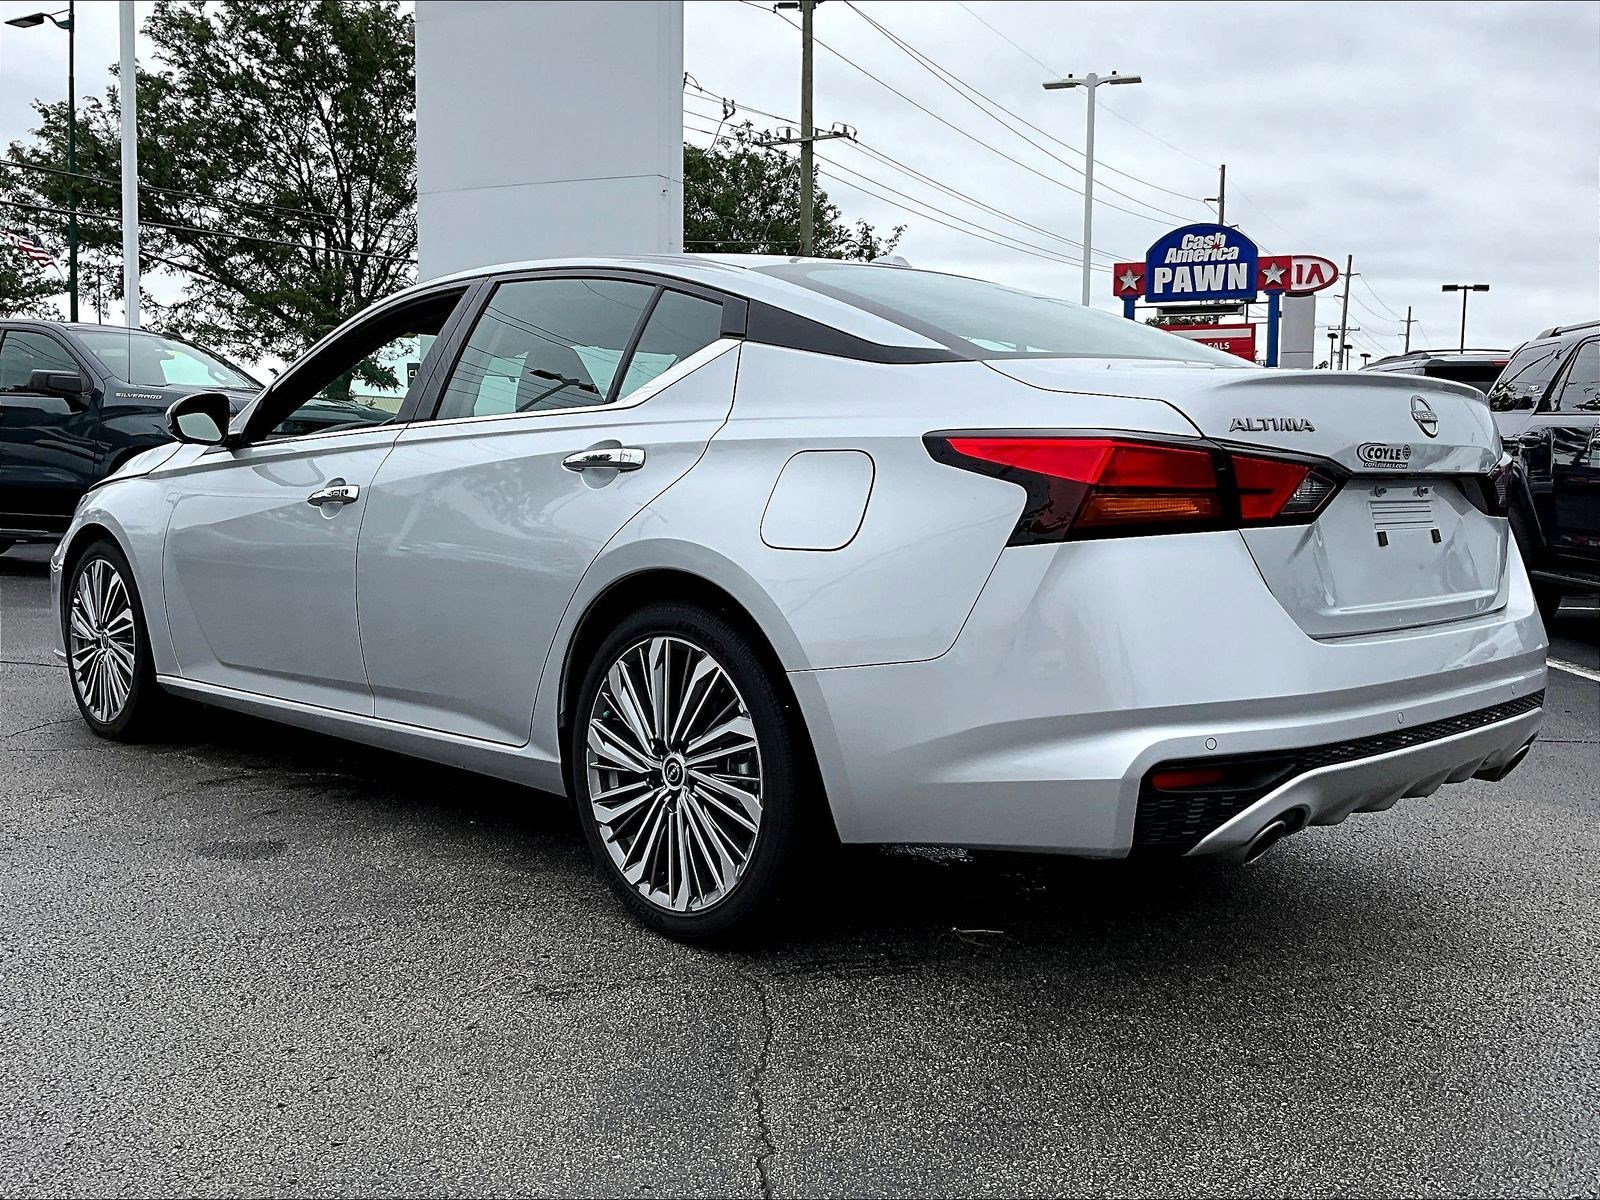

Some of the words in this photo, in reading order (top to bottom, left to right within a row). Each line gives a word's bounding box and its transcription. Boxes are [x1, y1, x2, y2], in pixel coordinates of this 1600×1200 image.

[1182, 232, 1226, 250] Cash
[1165, 246, 1239, 263] America
[1154, 262, 1248, 294] PAWN
[1292, 263, 1325, 285] IA
[1207, 342, 1230, 350] EALS
[115, 392, 163, 400] SILVERADO
[1229, 417, 1316, 432] ALTIMA
[1367, 447, 1402, 460] COYLE
